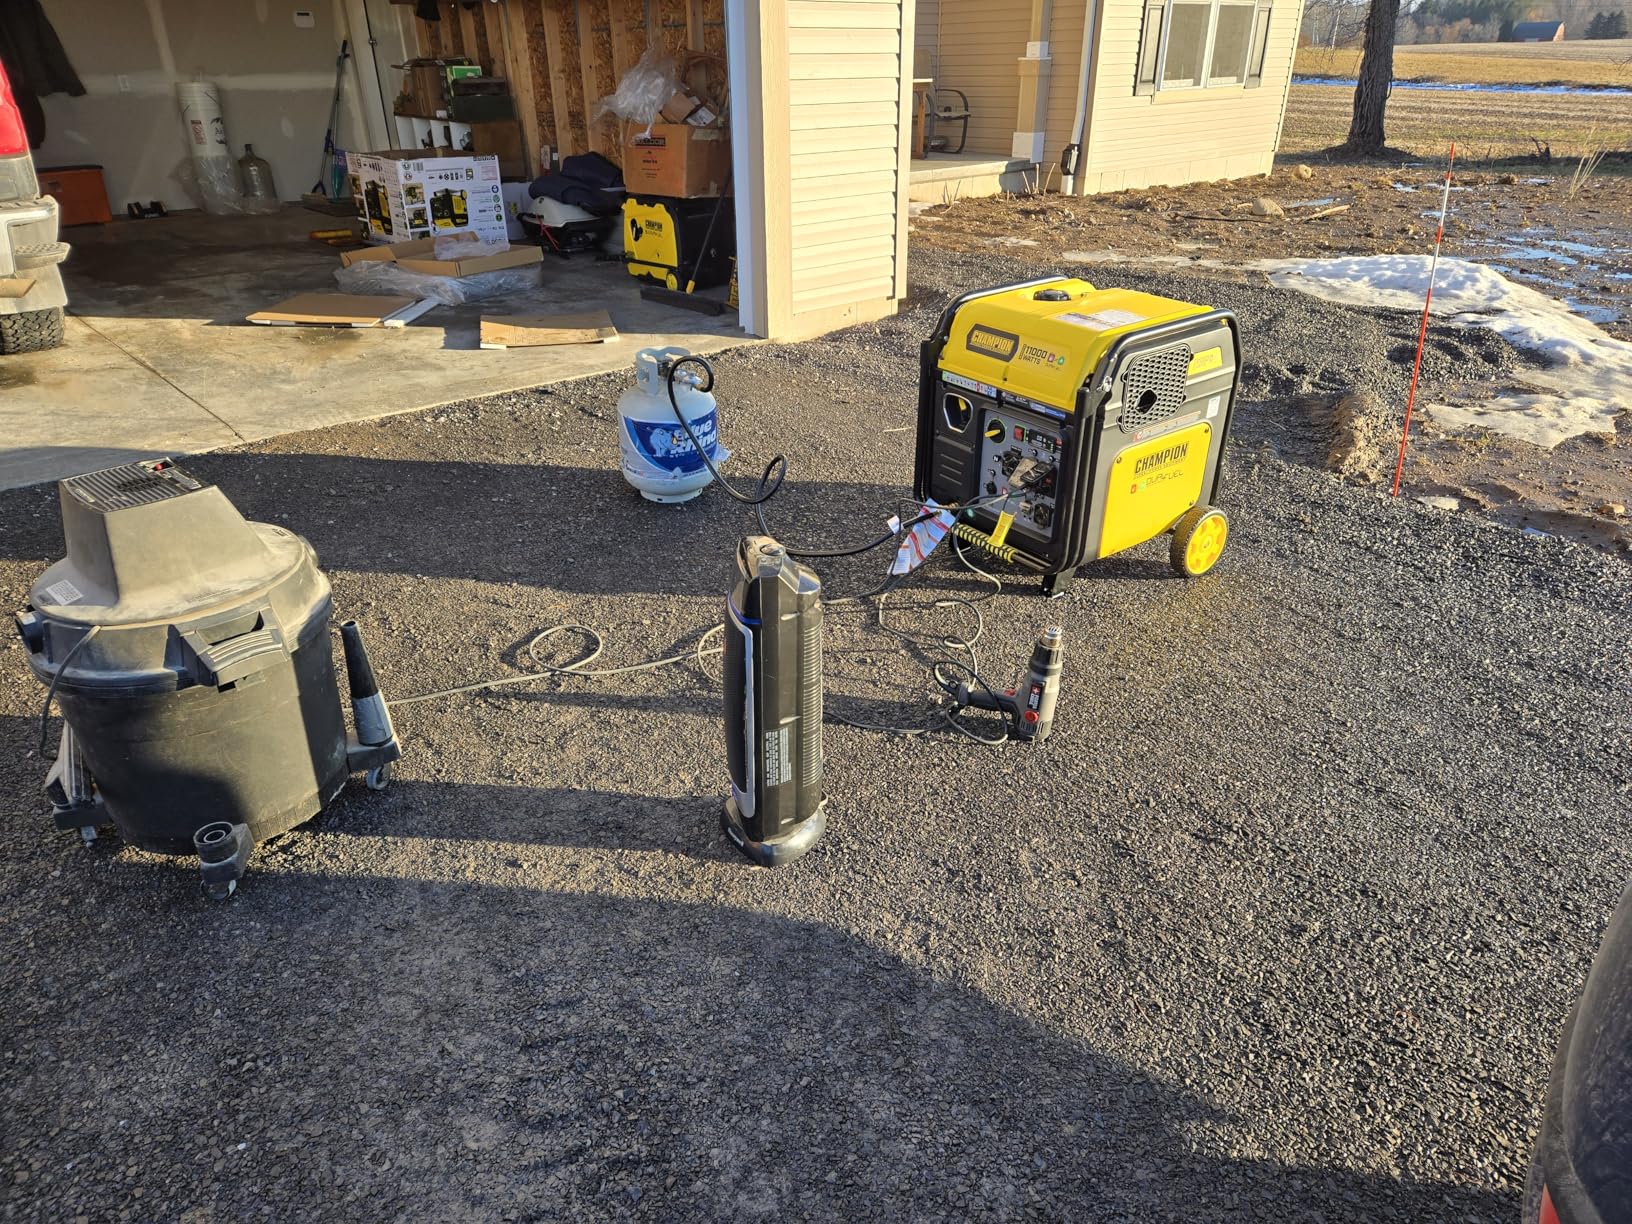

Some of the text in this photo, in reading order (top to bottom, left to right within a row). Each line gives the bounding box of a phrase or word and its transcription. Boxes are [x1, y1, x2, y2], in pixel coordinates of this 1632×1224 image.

[972, 329, 1014, 352] CHAMPION
[1022, 356, 1041, 365] WATTS
[1024, 346, 1048, 359] 11000
[1135, 443, 1188, 474] CHAMPION
